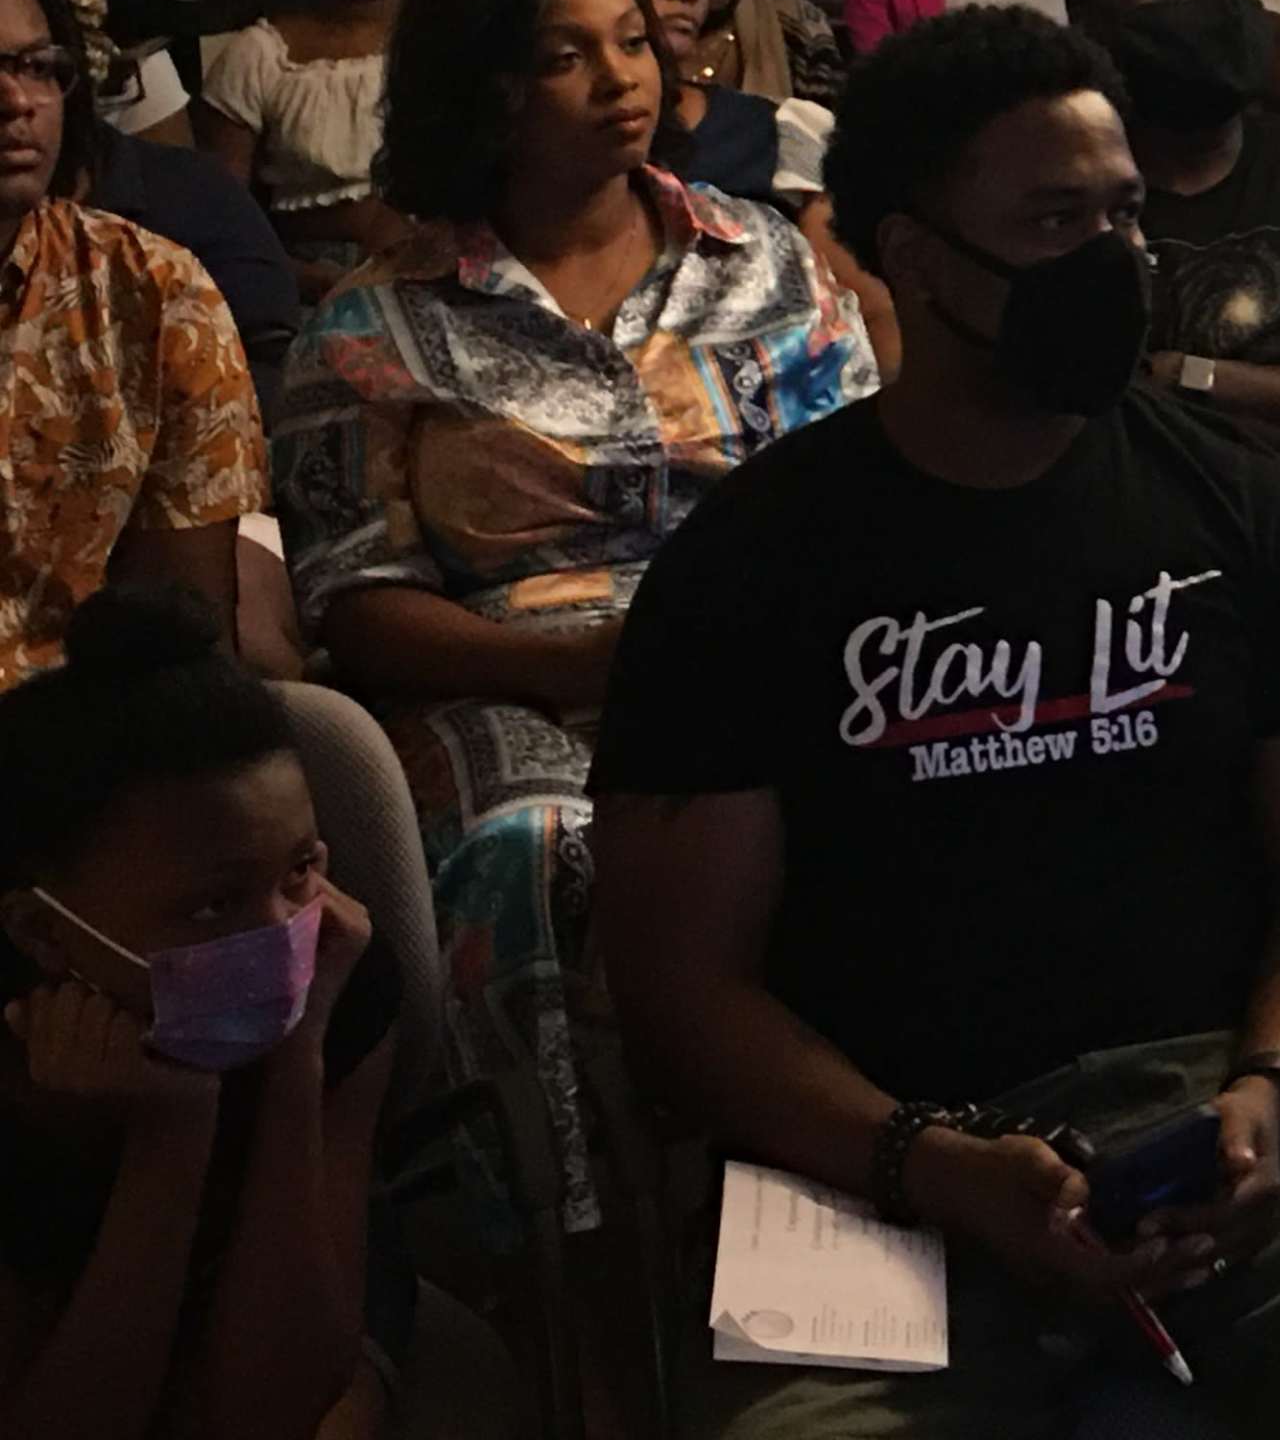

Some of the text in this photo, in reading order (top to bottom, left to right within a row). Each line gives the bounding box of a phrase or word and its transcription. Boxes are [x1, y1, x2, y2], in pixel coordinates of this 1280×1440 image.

[838, 569, 1222, 747] Stay Lit
[907, 709, 1160, 782] Matthew 5:16
